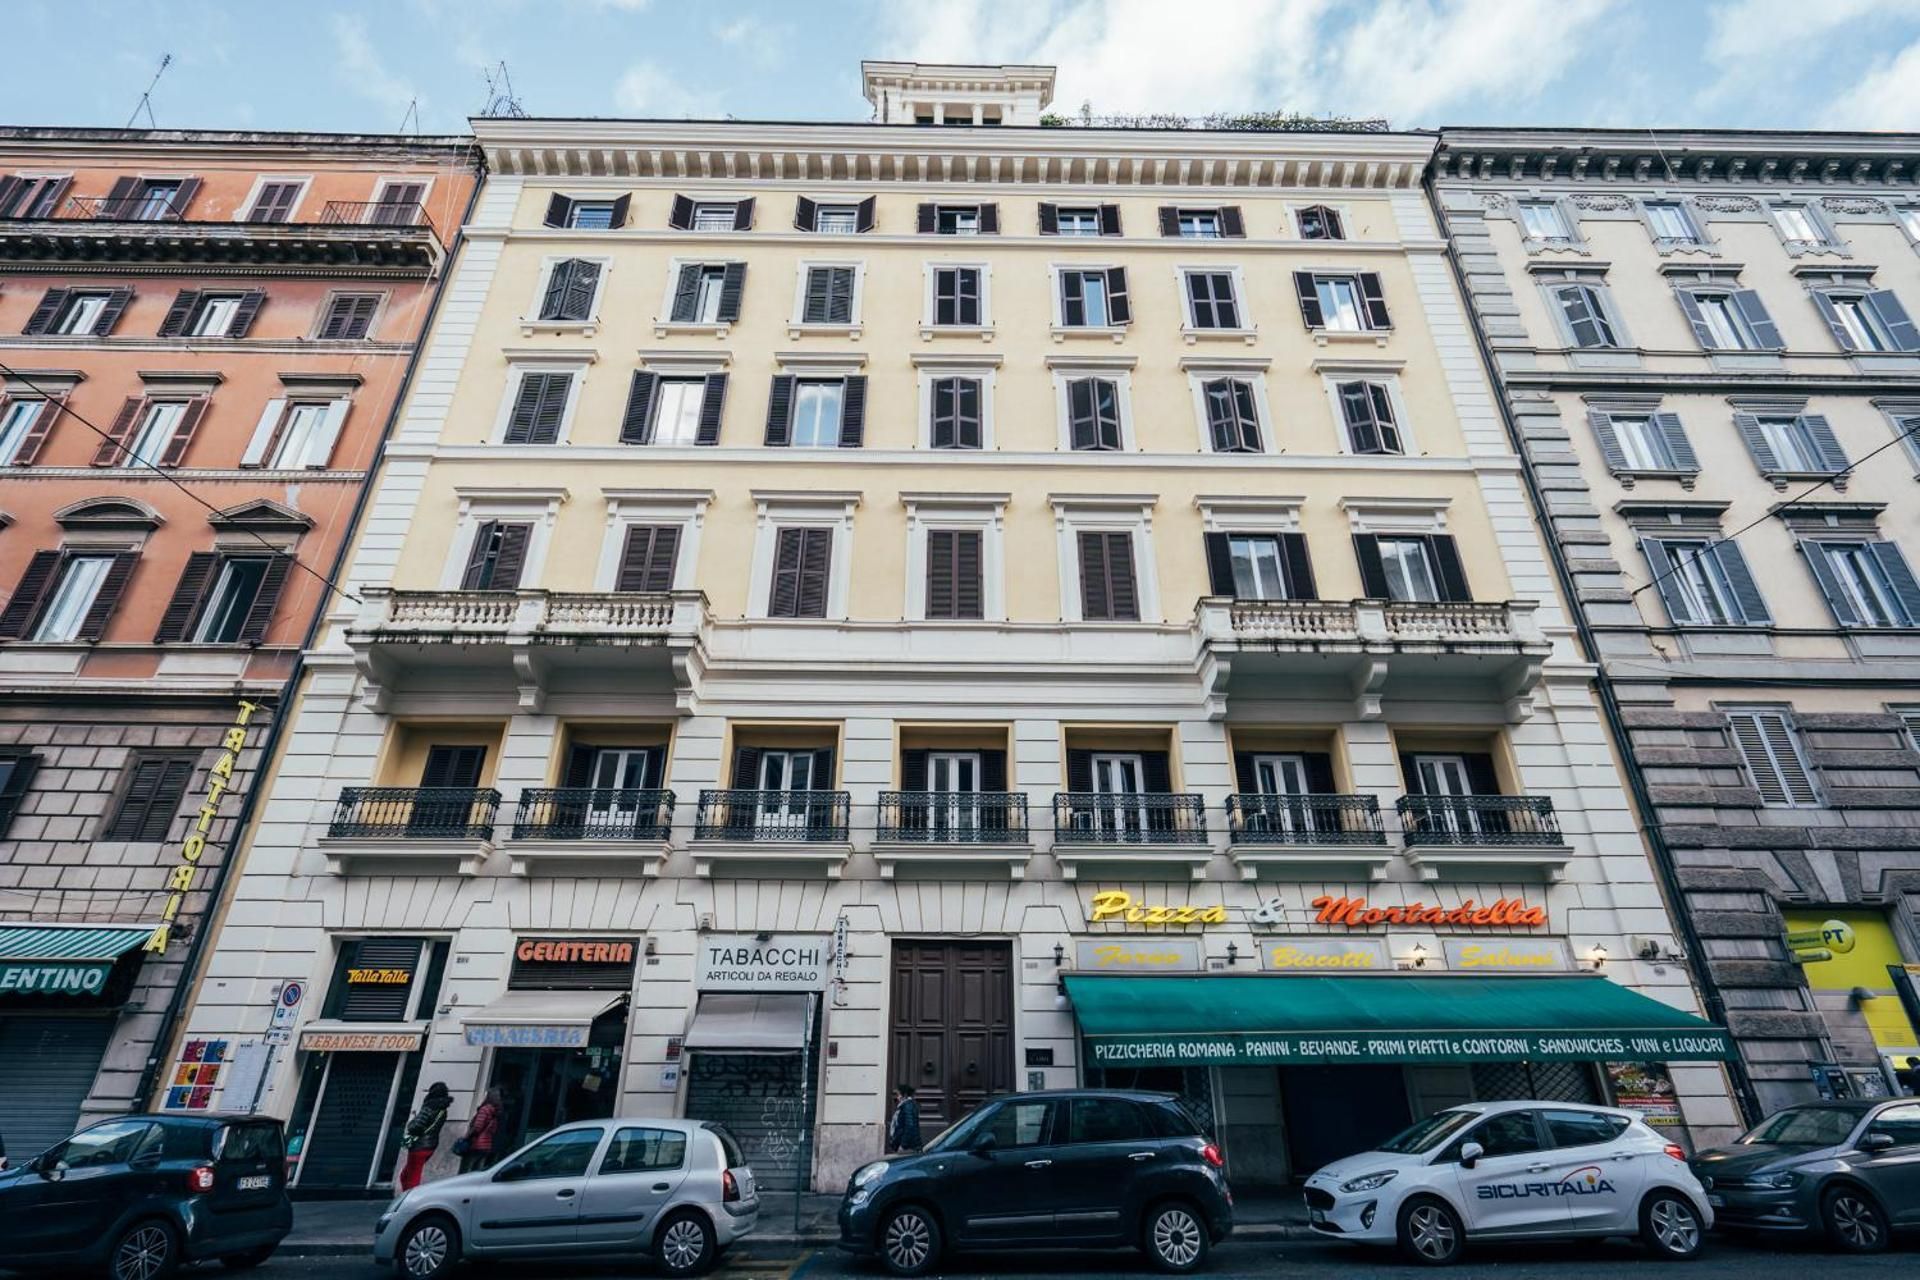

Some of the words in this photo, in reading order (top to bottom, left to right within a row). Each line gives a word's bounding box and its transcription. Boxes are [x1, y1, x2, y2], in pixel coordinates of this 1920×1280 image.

[1092, 890, 1228, 924] Pizza
[1252, 896, 1284, 924] &
[1312, 895, 1547, 926] Mortadella
[1823, 929, 1844, 944] PT
[517, 940, 634, 962] GELATERIA
[709, 948, 819, 966] TABACCHI
[1271, 946, 1374, 968] Biscotti
[0, 968, 103, 989] ENTINO
[347, 969, 379, 984] Yalla
[378, 969, 410, 984] Yalla
[706, 971, 754, 982] ARTICOLI
[757, 971, 772, 982] DA
[775, 971, 818, 982] REGALO
[303, 1035, 377, 1049] LEBANESE
[378, 1036, 417, 1049] FOOD
[1096, 1043, 1175, 1059] PIZZICHERIA
[1178, 1042, 1236, 1057] ROMANA
[1246, 1041, 1290, 1056] PANINI
[1300, 1040, 1360, 1056] BEVANDE
[1368, 1040, 1405, 1055] PRIMI
[1408, 1039, 1450, 1054] PIATTI
[1453, 1042, 1460, 1054] e
[1462, 1039, 1529, 1054] CONTORNI
[1538, 1038, 1624, 1053] SANDWICHES
[1631, 1038, 1659, 1053] VINI
[1663, 1041, 1670, 1053] e
[1672, 1038, 1725, 1053] LIQUORI
[1477, 1179, 1616, 1199] SICURITALIA
